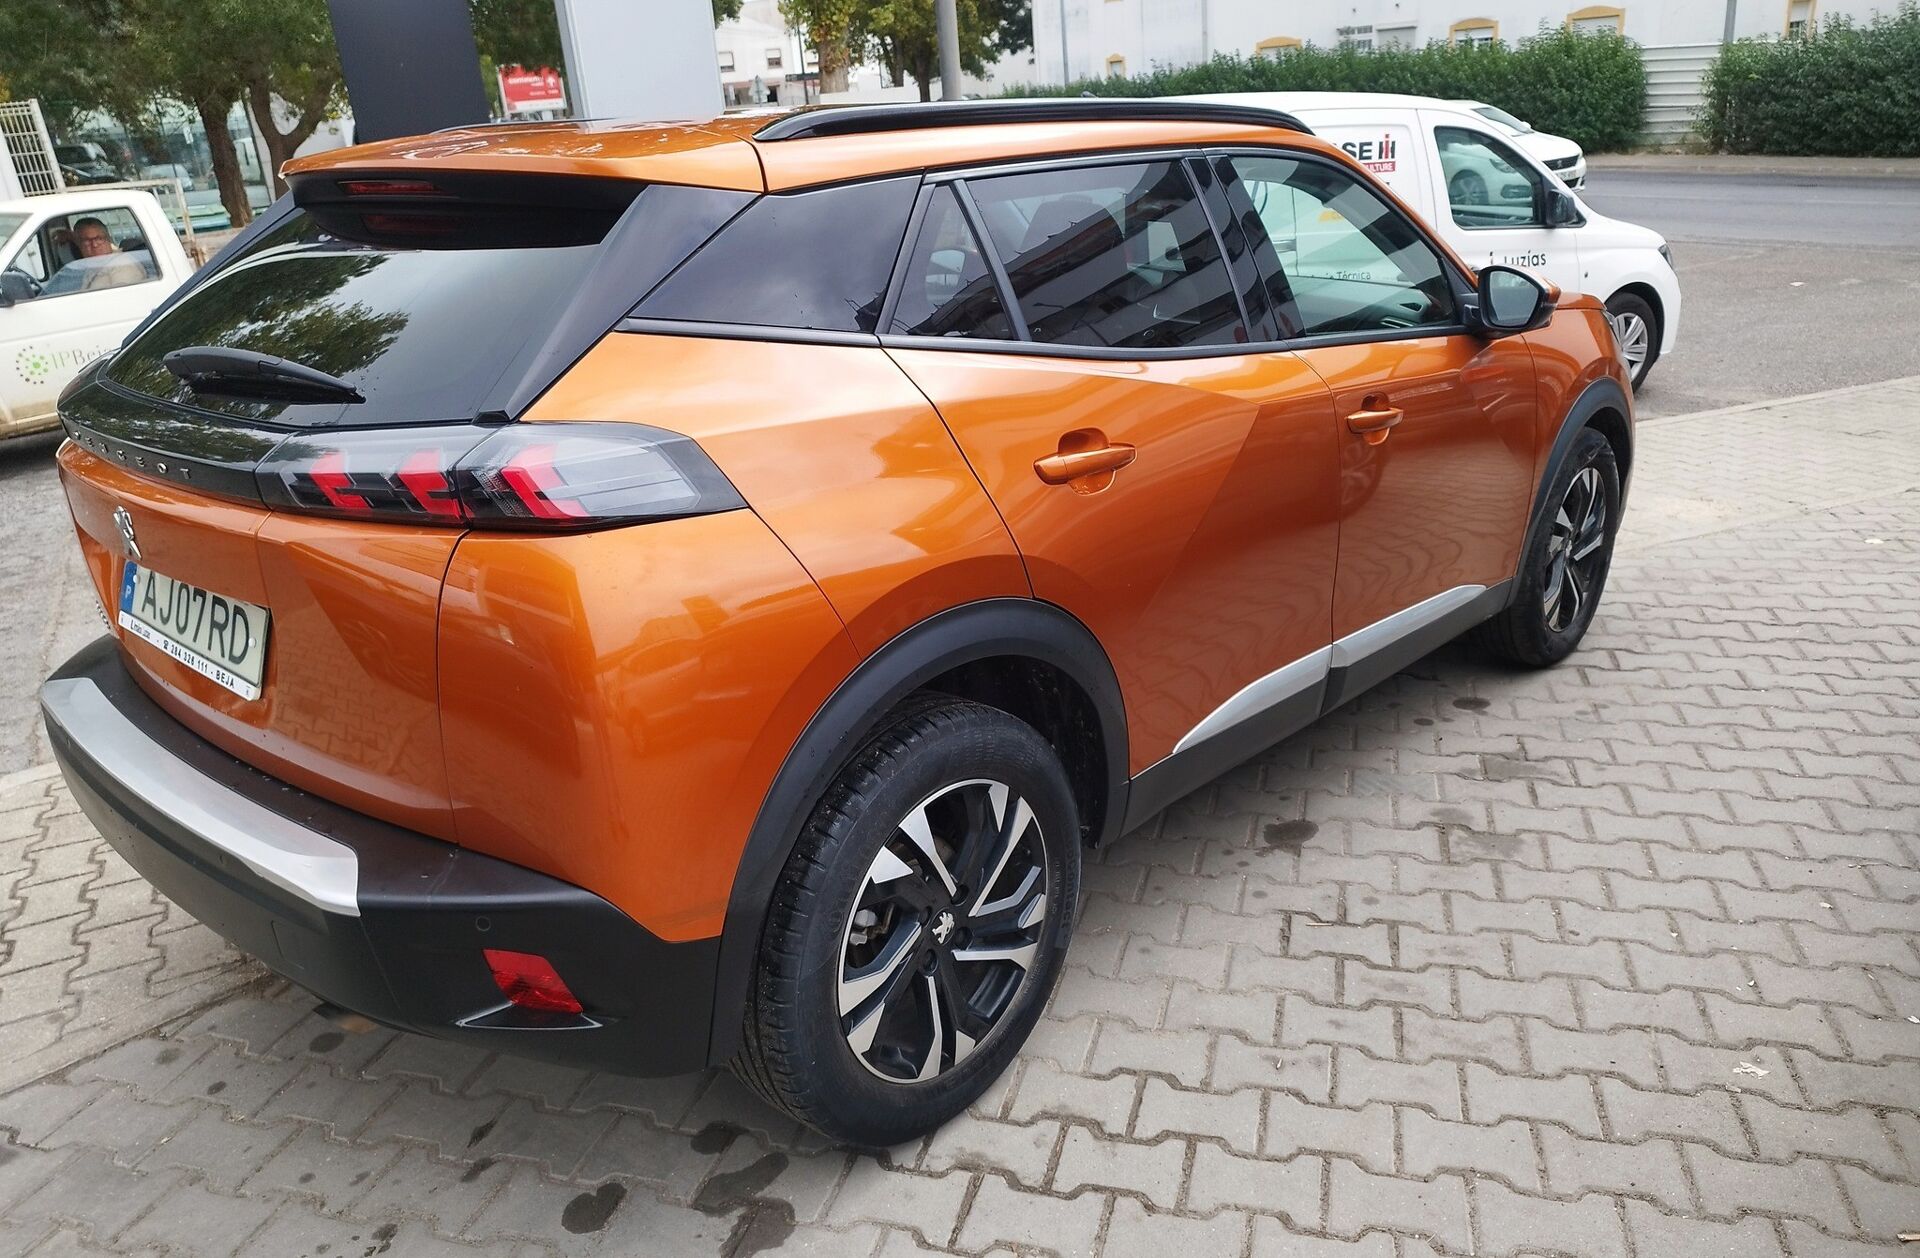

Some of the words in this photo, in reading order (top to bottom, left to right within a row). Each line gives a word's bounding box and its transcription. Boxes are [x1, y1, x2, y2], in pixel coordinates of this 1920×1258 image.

[1334, 142, 1373, 160] SE
[74, 431, 191, 480] PEUGEOT
[141, 569, 250, 665] AJ07RD
[215, 670, 235, 689] BEJA
